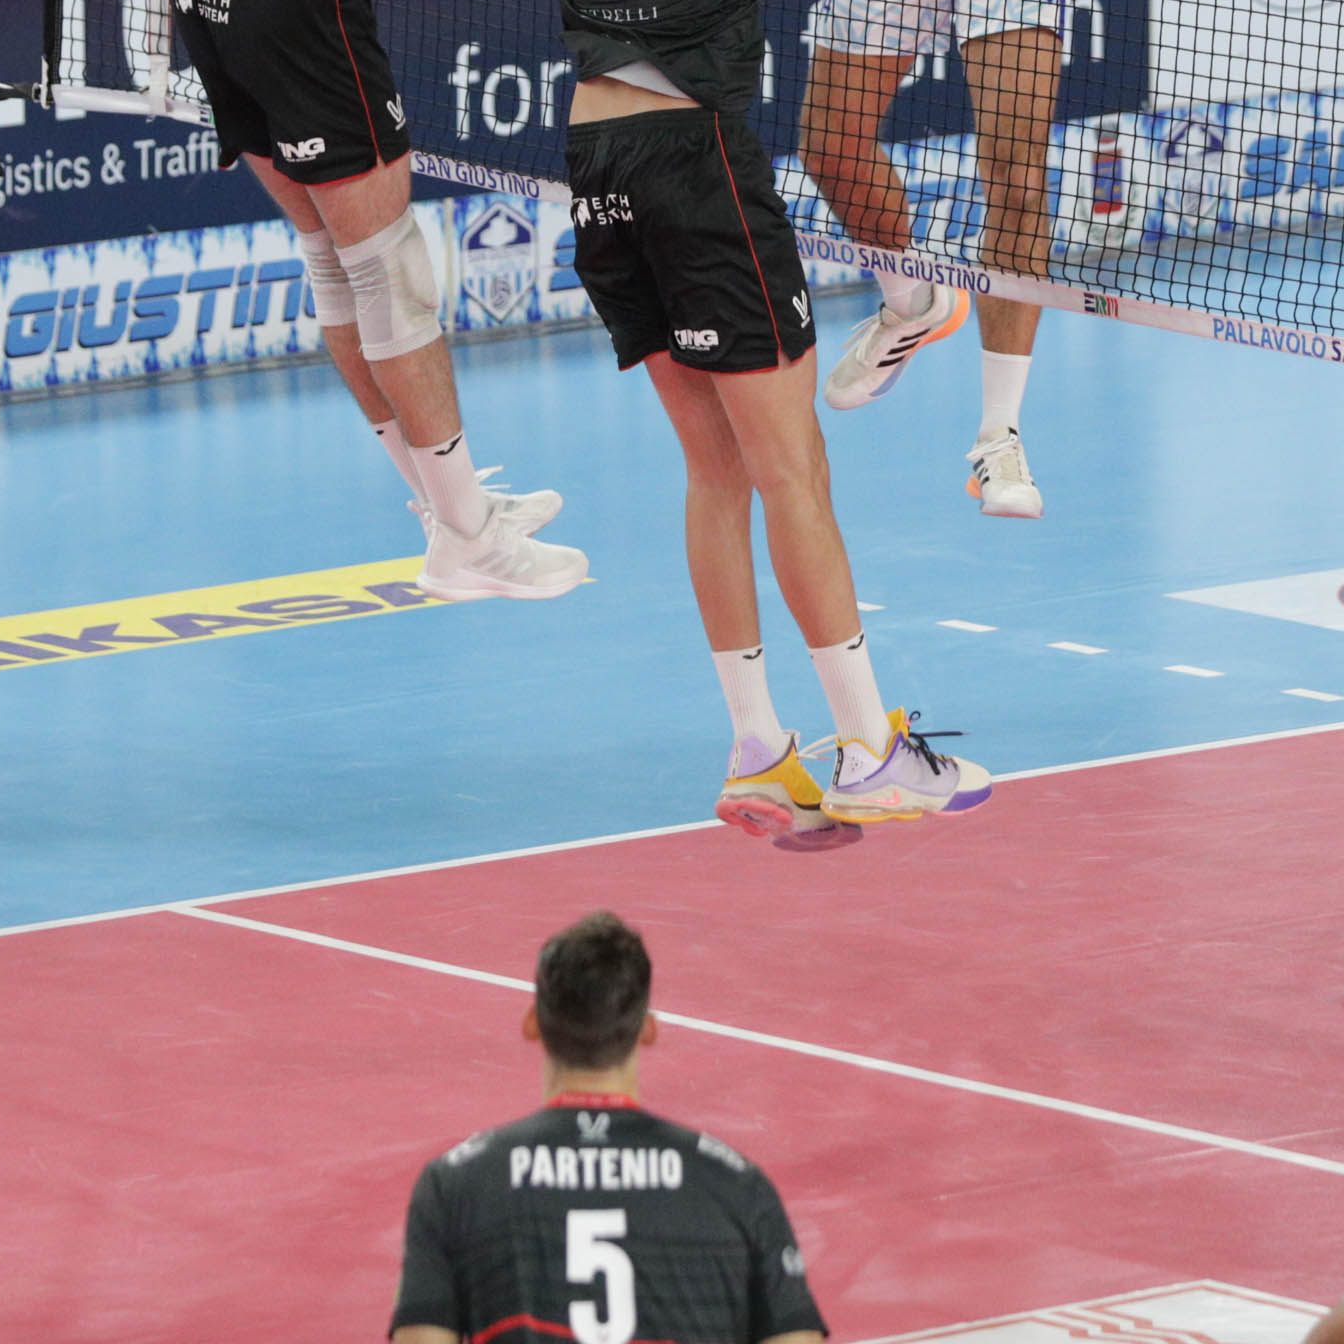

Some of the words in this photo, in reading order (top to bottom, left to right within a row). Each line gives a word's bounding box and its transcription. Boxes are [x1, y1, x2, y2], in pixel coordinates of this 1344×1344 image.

[103, 141, 138, 184] &
[149, 129, 238, 180] Traffi
[415, 153, 452, 180] SAN
[455, 164, 541, 199] GIUSTINO
[858, 246, 896, 275] SAN
[901, 256, 992, 296] GIUSTINO
[5, 258, 317, 358] GIUSTIN
[1213, 317, 1327, 359] PALLAVOLO
[510, 1145, 683, 1191] PARTENIO
[566, 1208, 637, 1344] 5
